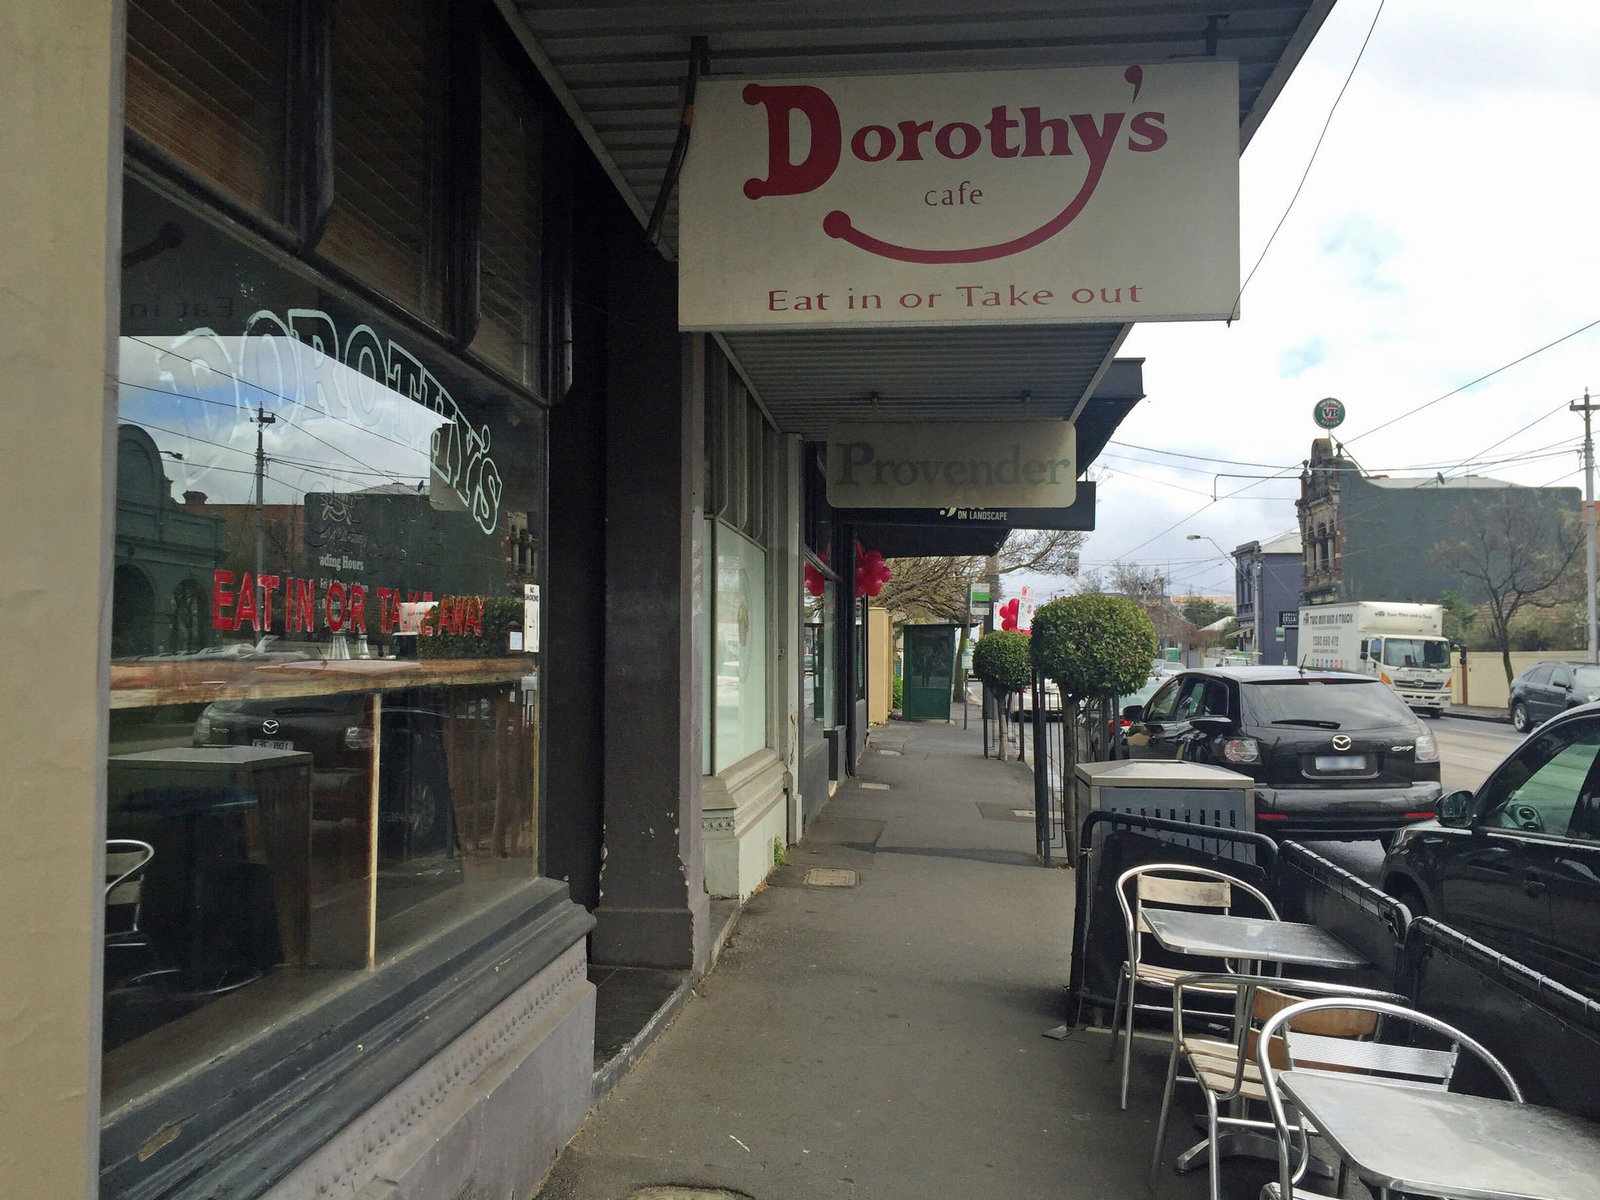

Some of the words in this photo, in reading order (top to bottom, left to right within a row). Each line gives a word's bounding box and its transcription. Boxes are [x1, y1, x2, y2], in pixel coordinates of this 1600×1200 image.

[743, 65, 1168, 264] Dorothy's
[924, 180, 984, 207] cafe
[767, 288, 830, 312] Eat
[847, 287, 882, 310] in
[899, 288, 942, 309] or
[956, 285, 1054, 308] Take
[1071, 283, 1144, 304] out
[156, 307, 503, 535] DOROTHY'S
[1323, 408, 1338, 417] VB
[834, 441, 1072, 487] Provender
[957, 510, 968, 520] ON
[969, 511, 1008, 520] LANDSCAPE
[342, 555, 365, 571] Hours
[212, 569, 281, 632] EAT
[285, 576, 315, 633] IN
[326, 581, 367, 633] OR
[376, 586, 434, 637] TAKE
[437, 593, 488, 638] AWAY
